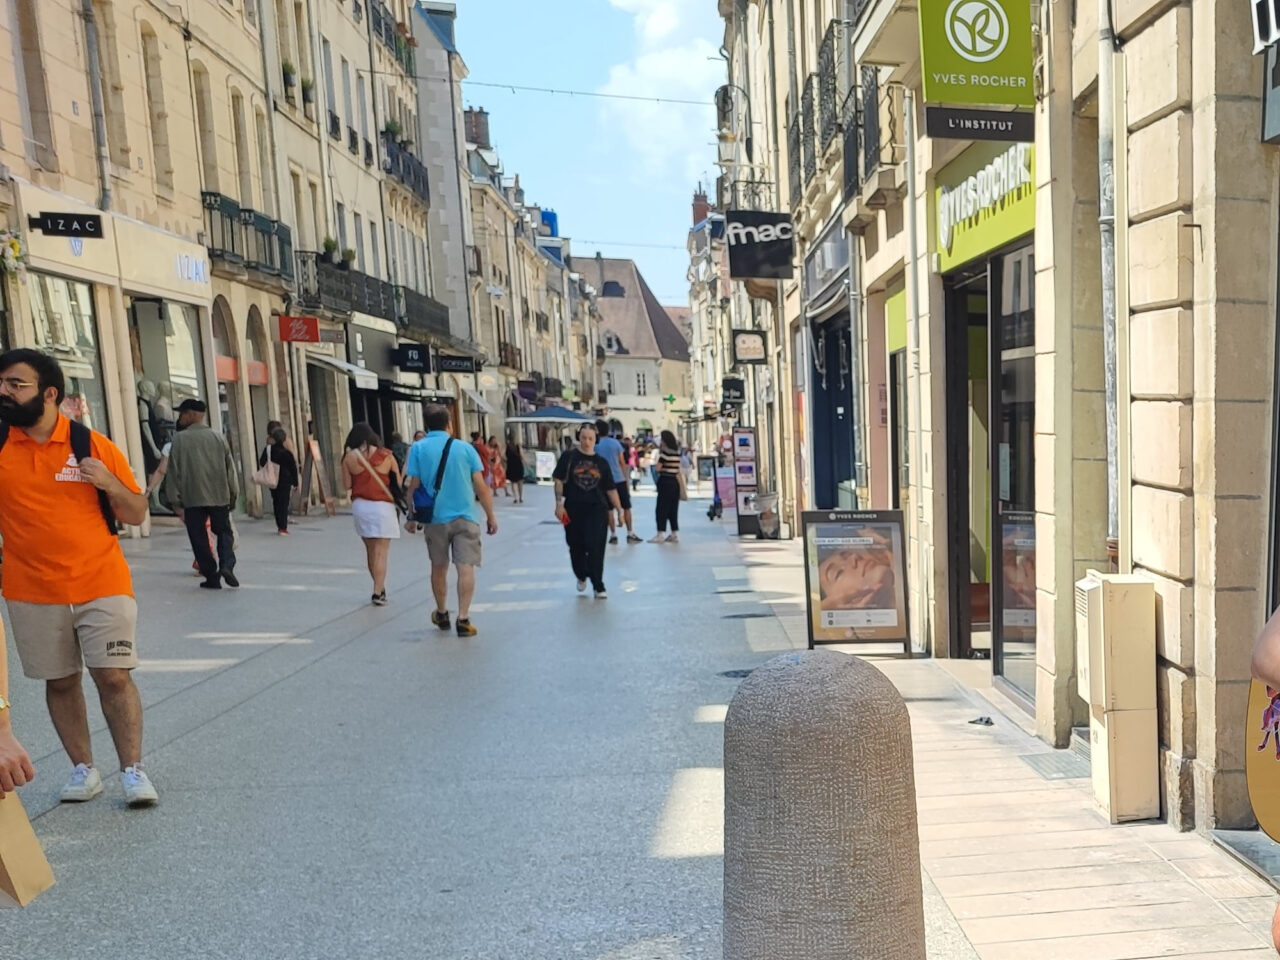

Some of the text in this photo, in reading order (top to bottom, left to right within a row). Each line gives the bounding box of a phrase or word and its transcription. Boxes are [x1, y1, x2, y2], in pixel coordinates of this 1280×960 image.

[933, 73, 1026, 87] YVES ROCHER
[949, 118, 1013, 131] L'INSTITUT
[950, 142, 1031, 226] YVES ROCHER
[47, 219, 95, 232] IZAC
[726, 221, 793, 246] fnac
[175, 253, 208, 284] IZAC
